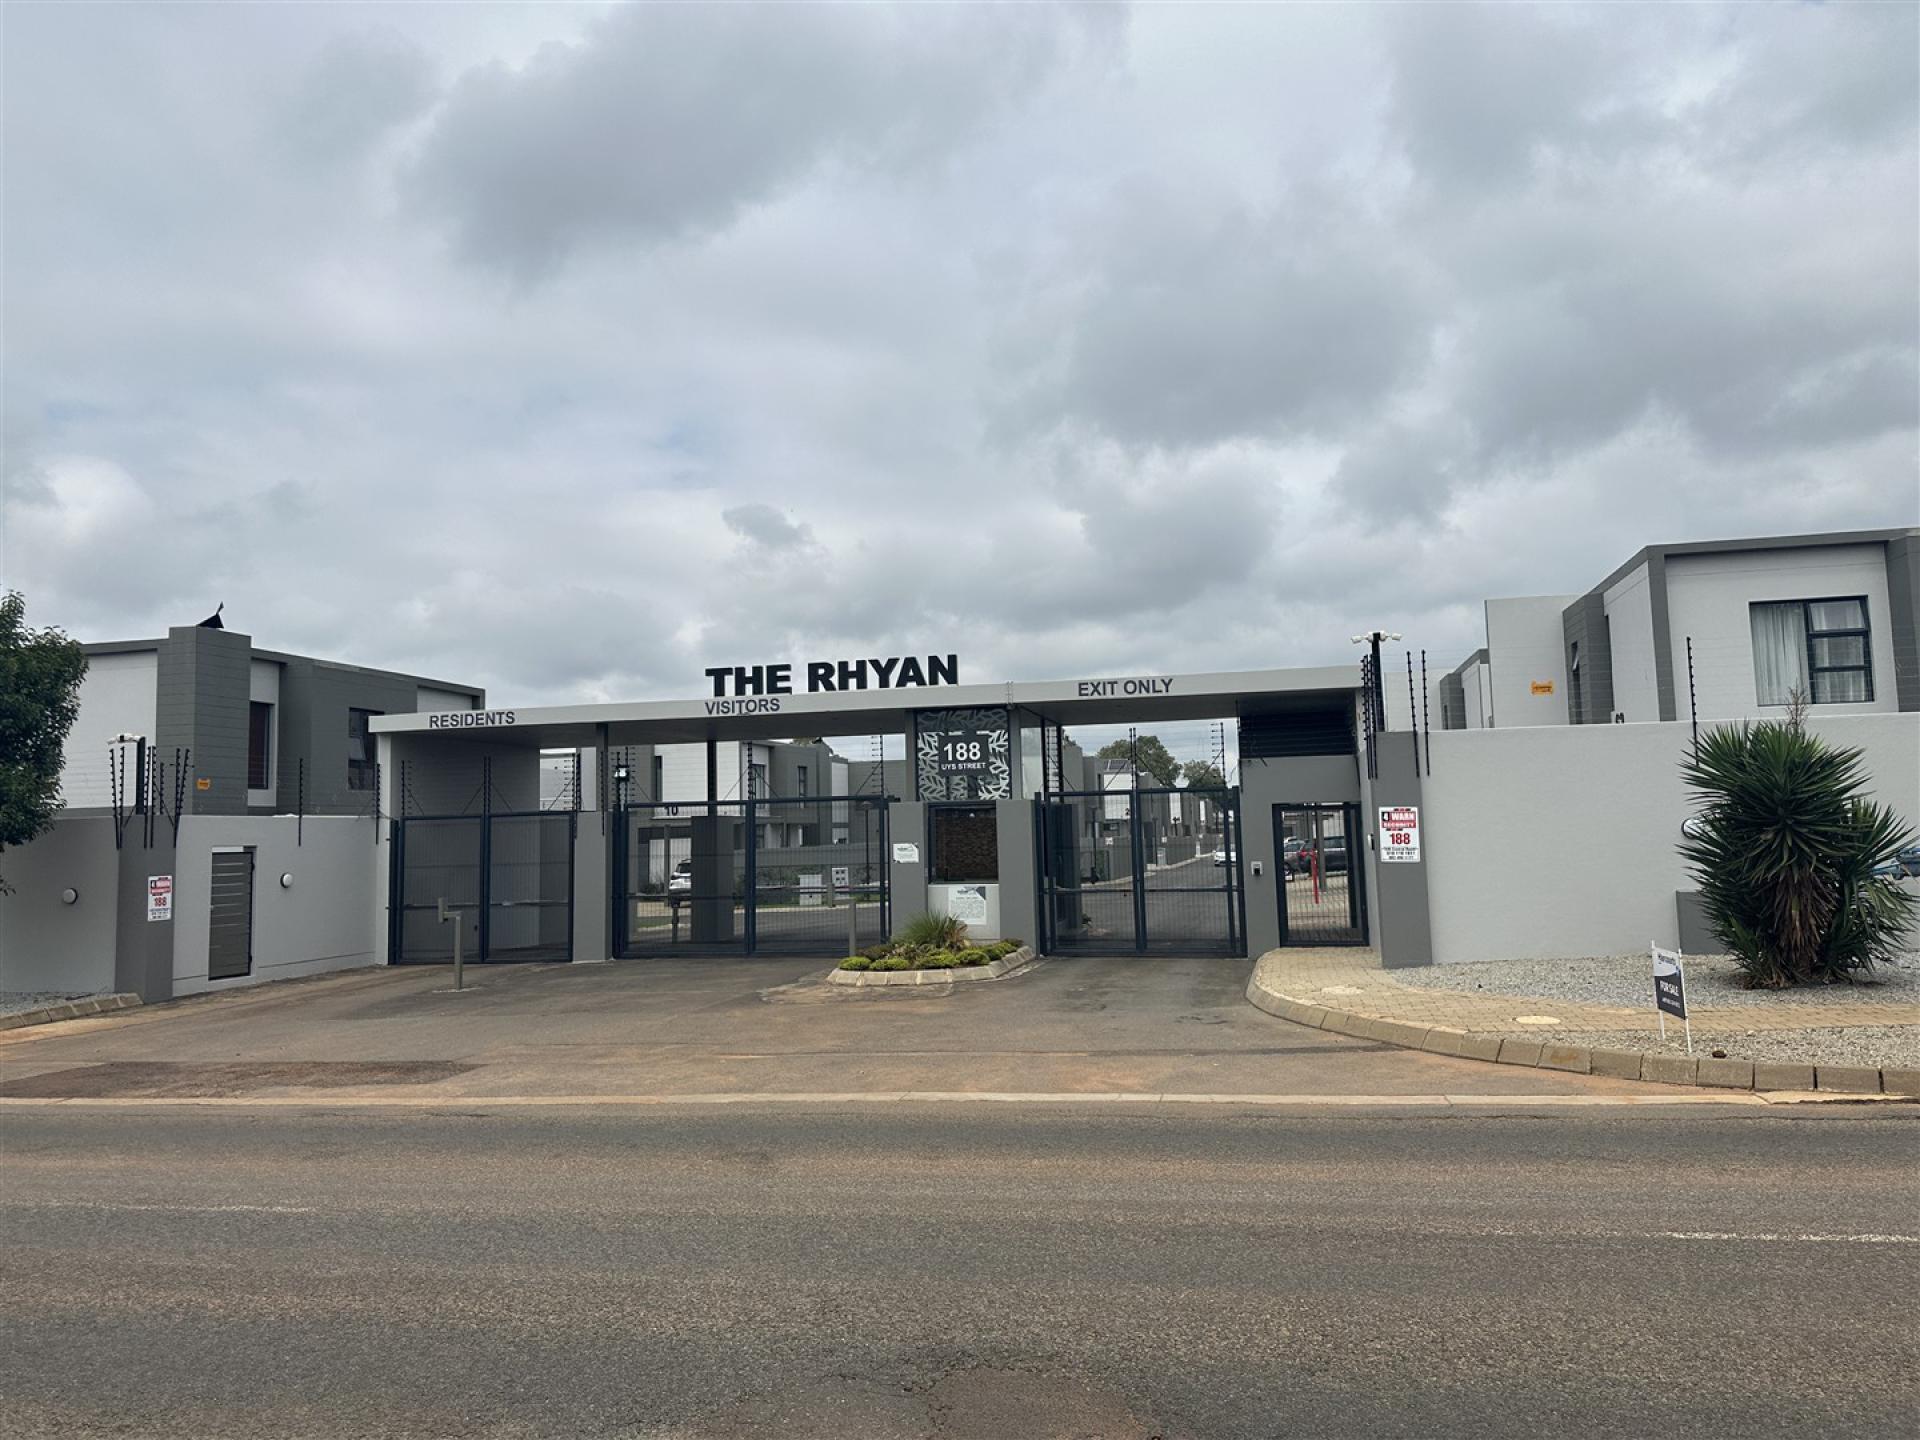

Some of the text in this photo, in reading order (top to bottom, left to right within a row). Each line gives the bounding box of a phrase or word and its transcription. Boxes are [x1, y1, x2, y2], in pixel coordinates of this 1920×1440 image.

[705, 654, 958, 697] THE RHYAN
[1078, 678, 1173, 696] EXIT ONLY
[704, 698, 780, 715] VISITORS
[429, 711, 515, 728] RESIDENTS
[943, 741, 981, 761] 188
[1390, 833, 1410, 844] 188
[155, 897, 167, 907] 188
